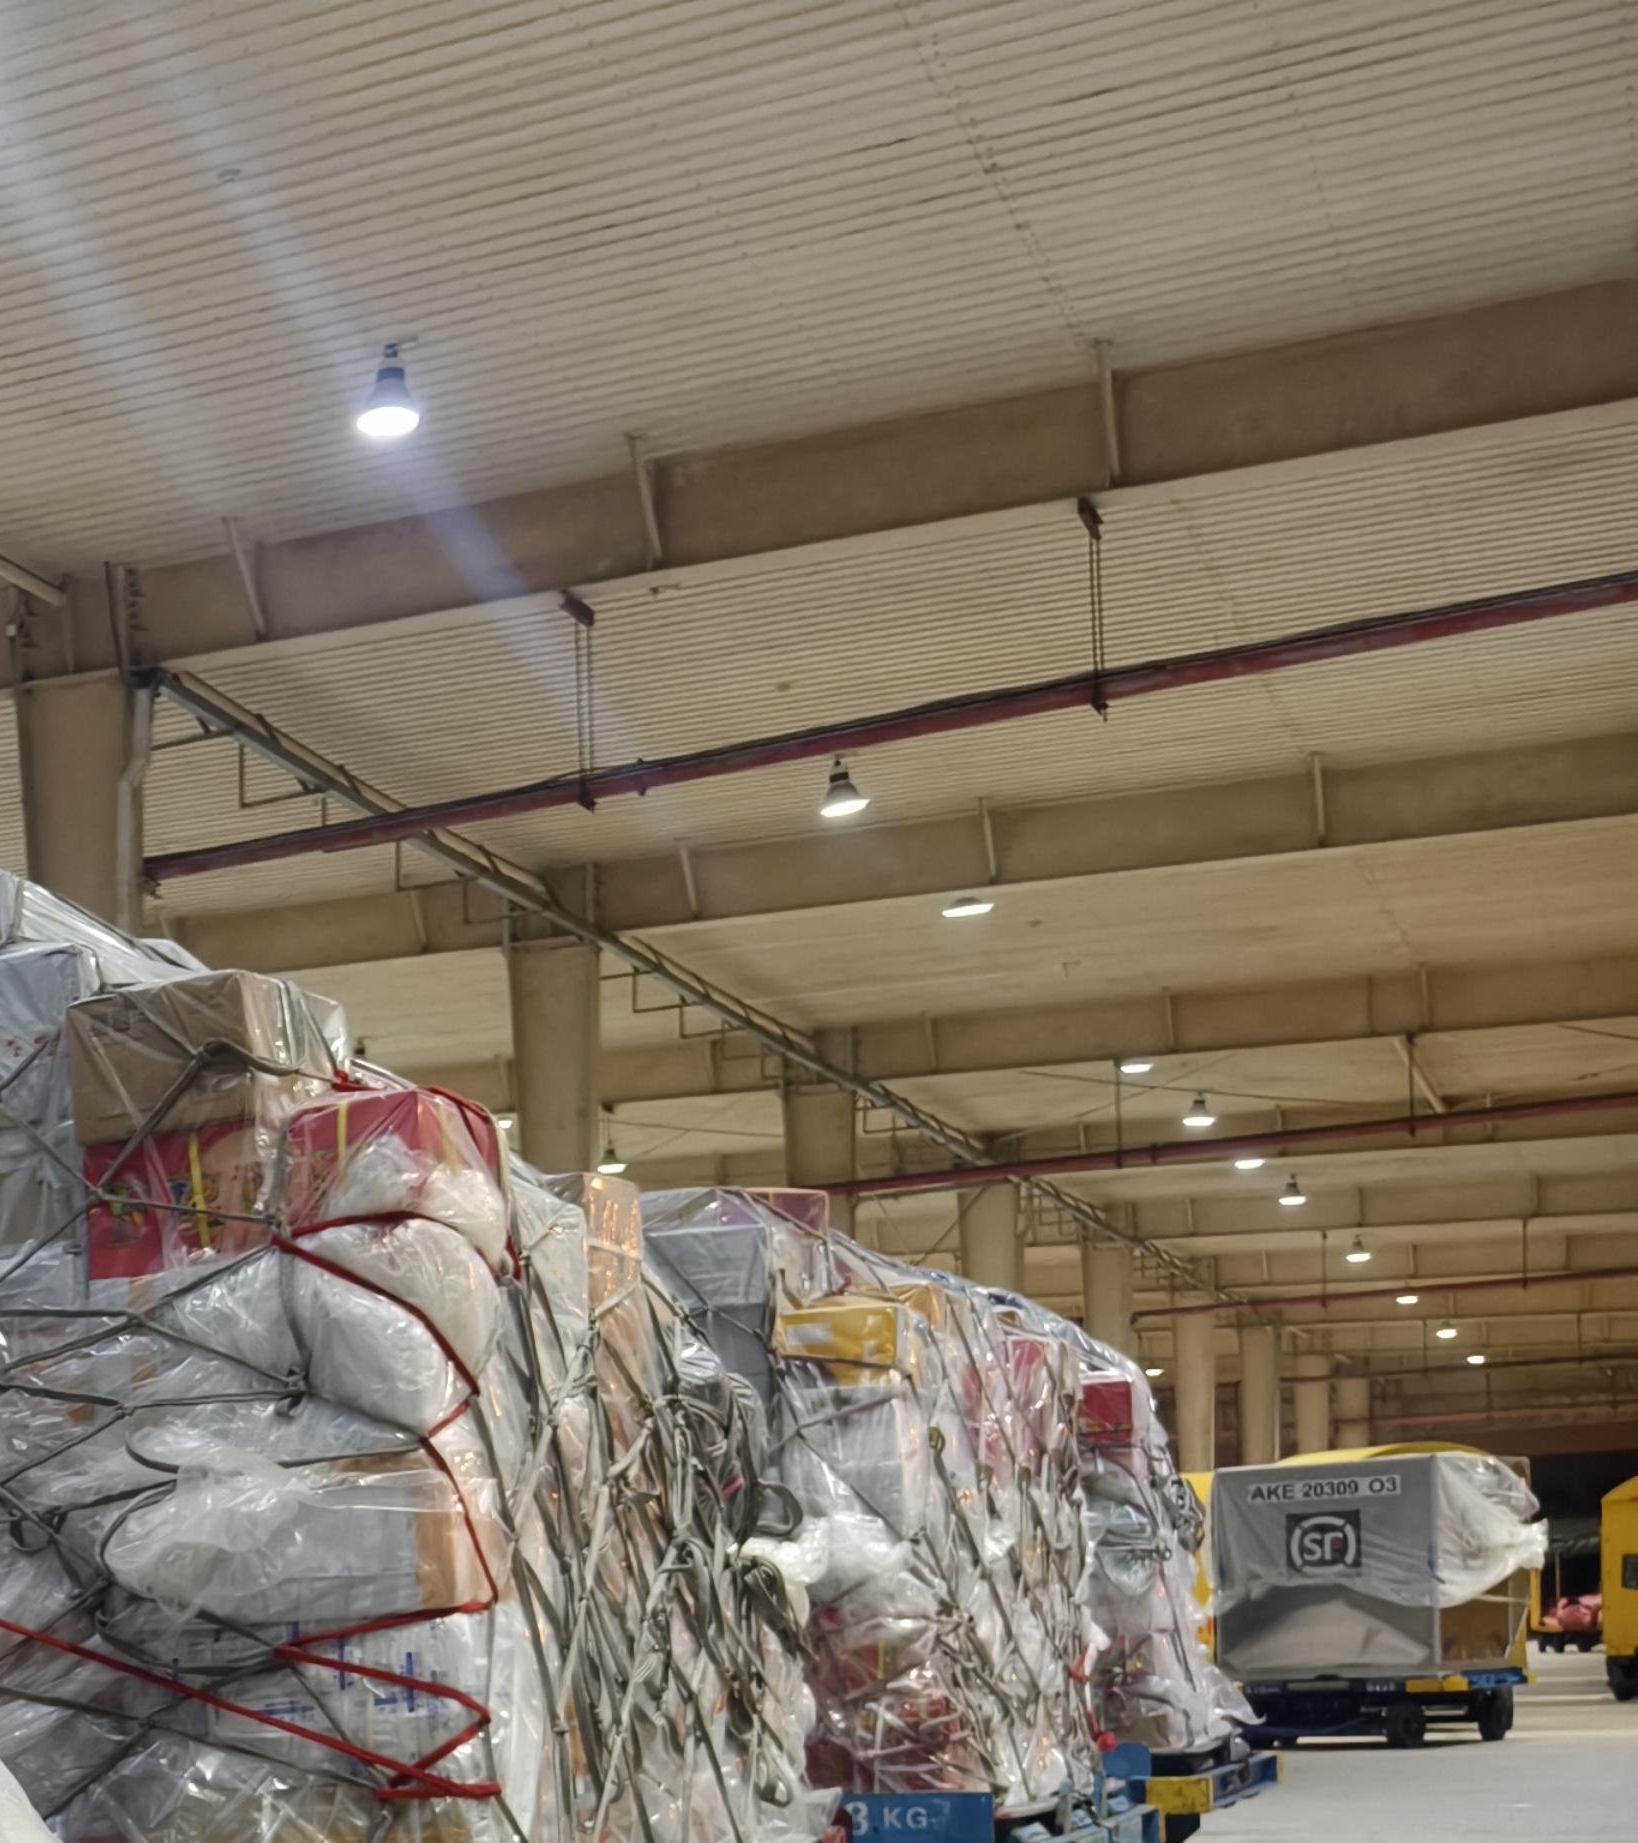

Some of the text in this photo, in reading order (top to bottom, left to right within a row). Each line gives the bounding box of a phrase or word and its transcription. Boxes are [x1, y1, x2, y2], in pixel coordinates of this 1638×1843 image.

[1251, 1484, 1295, 1502] AKE
[1302, 1480, 1359, 1499] 20309
[883, 1806, 928, 1830] KG
